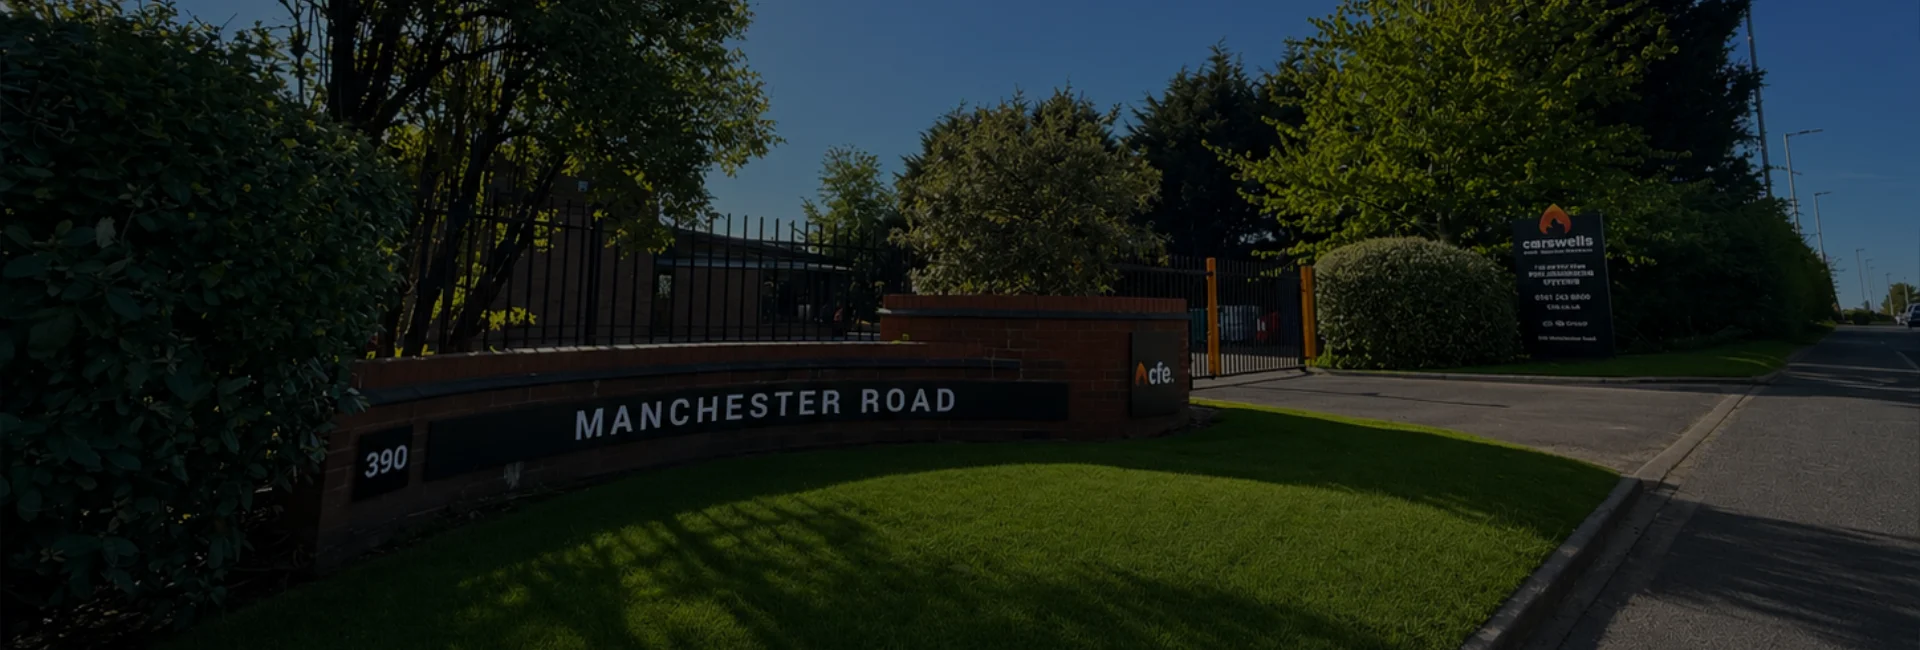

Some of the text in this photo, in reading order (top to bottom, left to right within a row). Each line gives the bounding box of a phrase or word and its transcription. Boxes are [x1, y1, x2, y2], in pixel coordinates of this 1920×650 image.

[575, 387, 956, 441] MANCHESTER ROAD
[365, 444, 408, 478] 390
